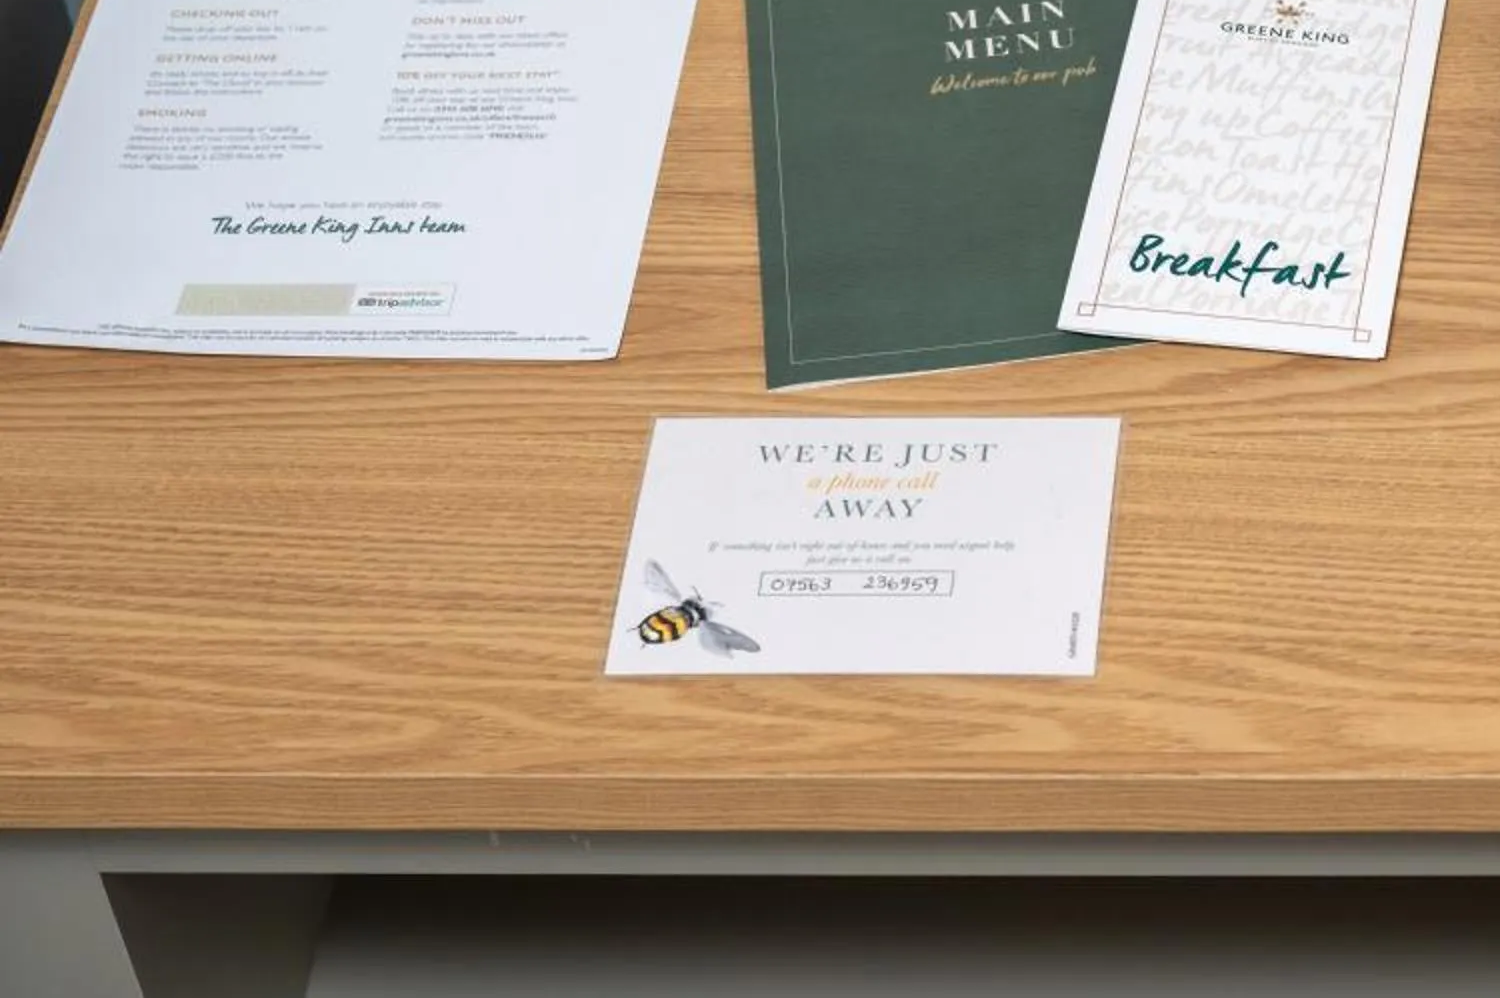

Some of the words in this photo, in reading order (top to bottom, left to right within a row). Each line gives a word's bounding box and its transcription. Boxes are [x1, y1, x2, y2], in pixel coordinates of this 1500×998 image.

[943, 26, 1076, 63] MENU
[1220, 20, 1296, 40] GREENE
[1301, 29, 1350, 45] KING
[1013, 67, 1029, 85] to
[1032, 70, 1057, 82] our
[210, 216, 242, 235] The
[246, 216, 308, 235] Greene
[310, 215, 360, 243] King
[363, 216, 416, 235] Inns
[418, 214, 467, 235] team
[1129, 234, 1351, 298] Breakfast
[759, 443, 885, 464] WE'RE
[894, 442, 999, 468] JUST
[806, 474, 823, 489] a
[825, 471, 891, 494] phone
[897, 470, 942, 490] call
[812, 498, 924, 519] AWAY
[770, 577, 832, 592] 07563
